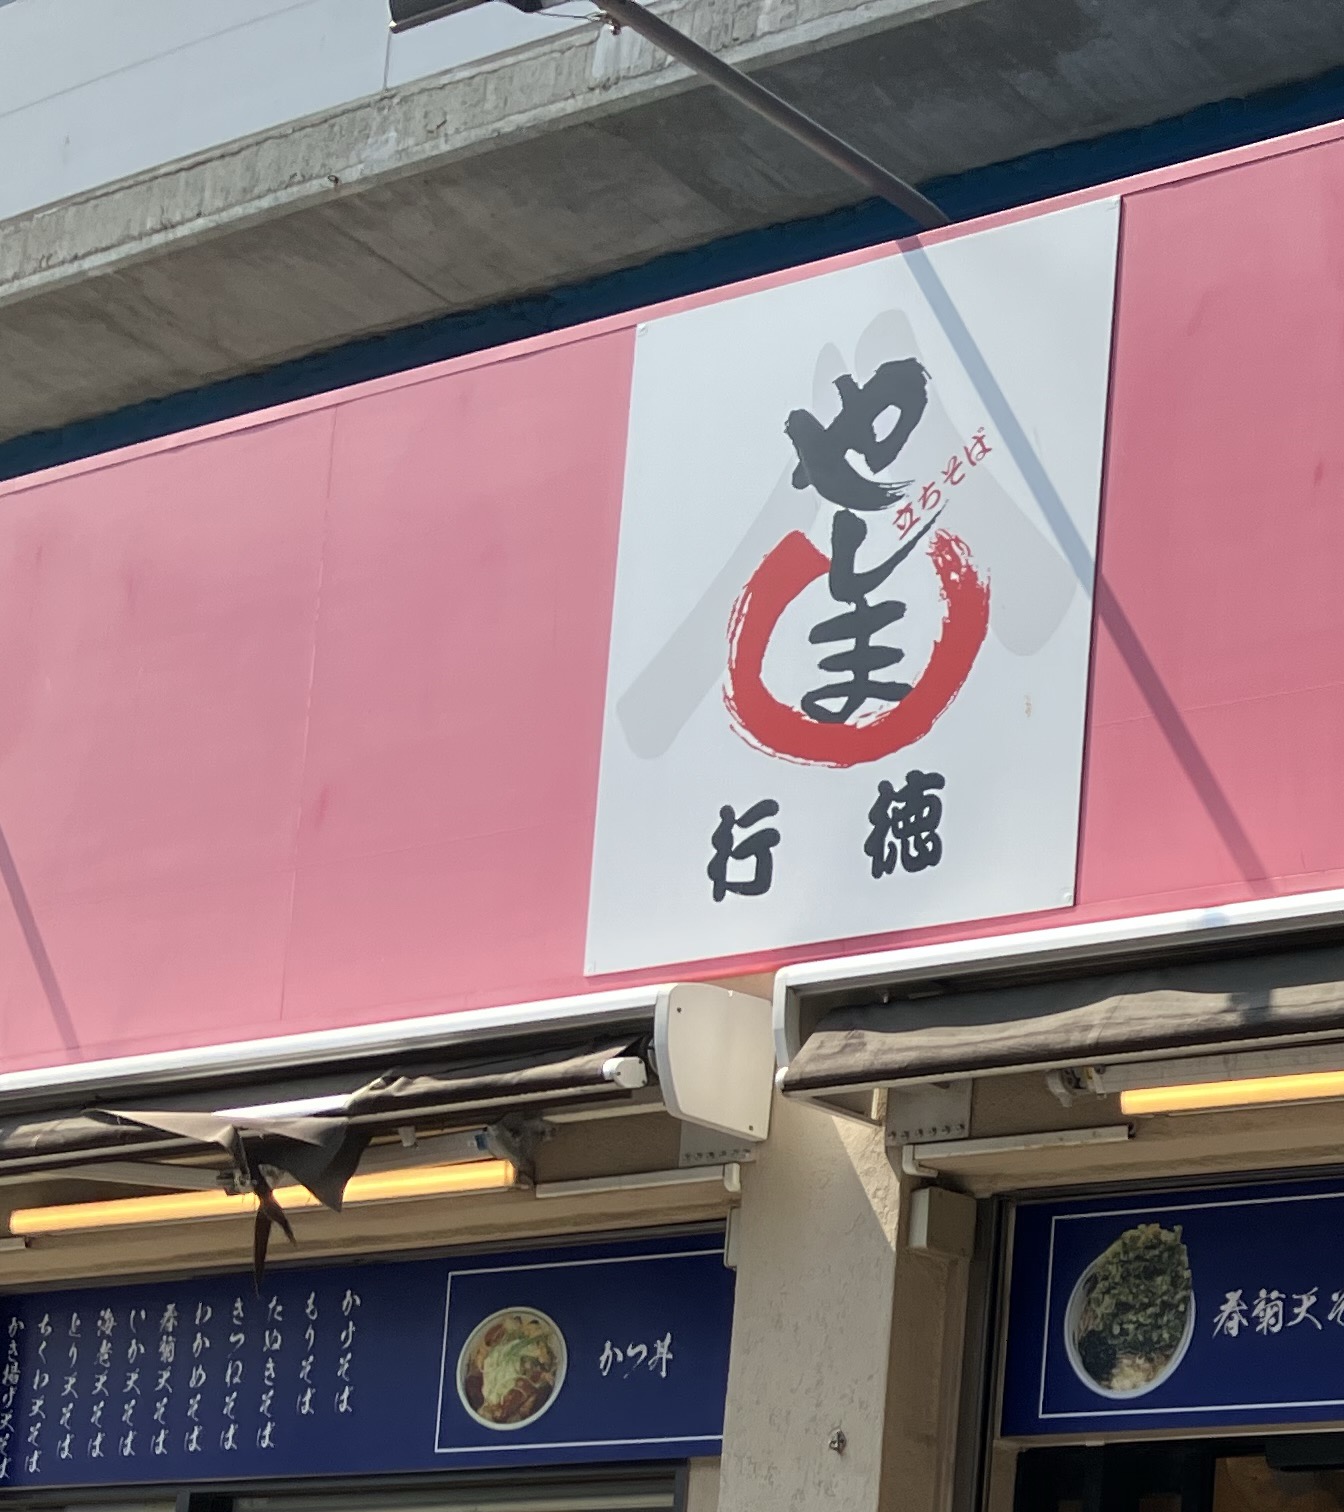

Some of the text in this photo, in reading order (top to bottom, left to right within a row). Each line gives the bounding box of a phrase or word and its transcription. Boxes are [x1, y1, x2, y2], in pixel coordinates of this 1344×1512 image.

[783, 357, 948, 723] やしま
[892, 426, 993, 540] 立ちそば
[707, 770, 945, 902] 行徳
[25, 1314, 51, 1472] ちくわ天そば
[57, 1312, 81, 1459] とり天そば
[88, 1308, 116, 1457] 海老天そば
[119, 1309, 145, 1456] いか天そば
[151, 1303, 177, 1455] 春菊天そば
[184, 1302, 212, 1451] わかめそば
[220, 1297, 245, 1449] きつねそば
[256, 1296, 282, 1448] たぬきそば
[297, 1291, 318, 1415] もりそば
[334, 1289, 360, 1413] かけそば
[600, 1333, 673, 1379] かつ丼
